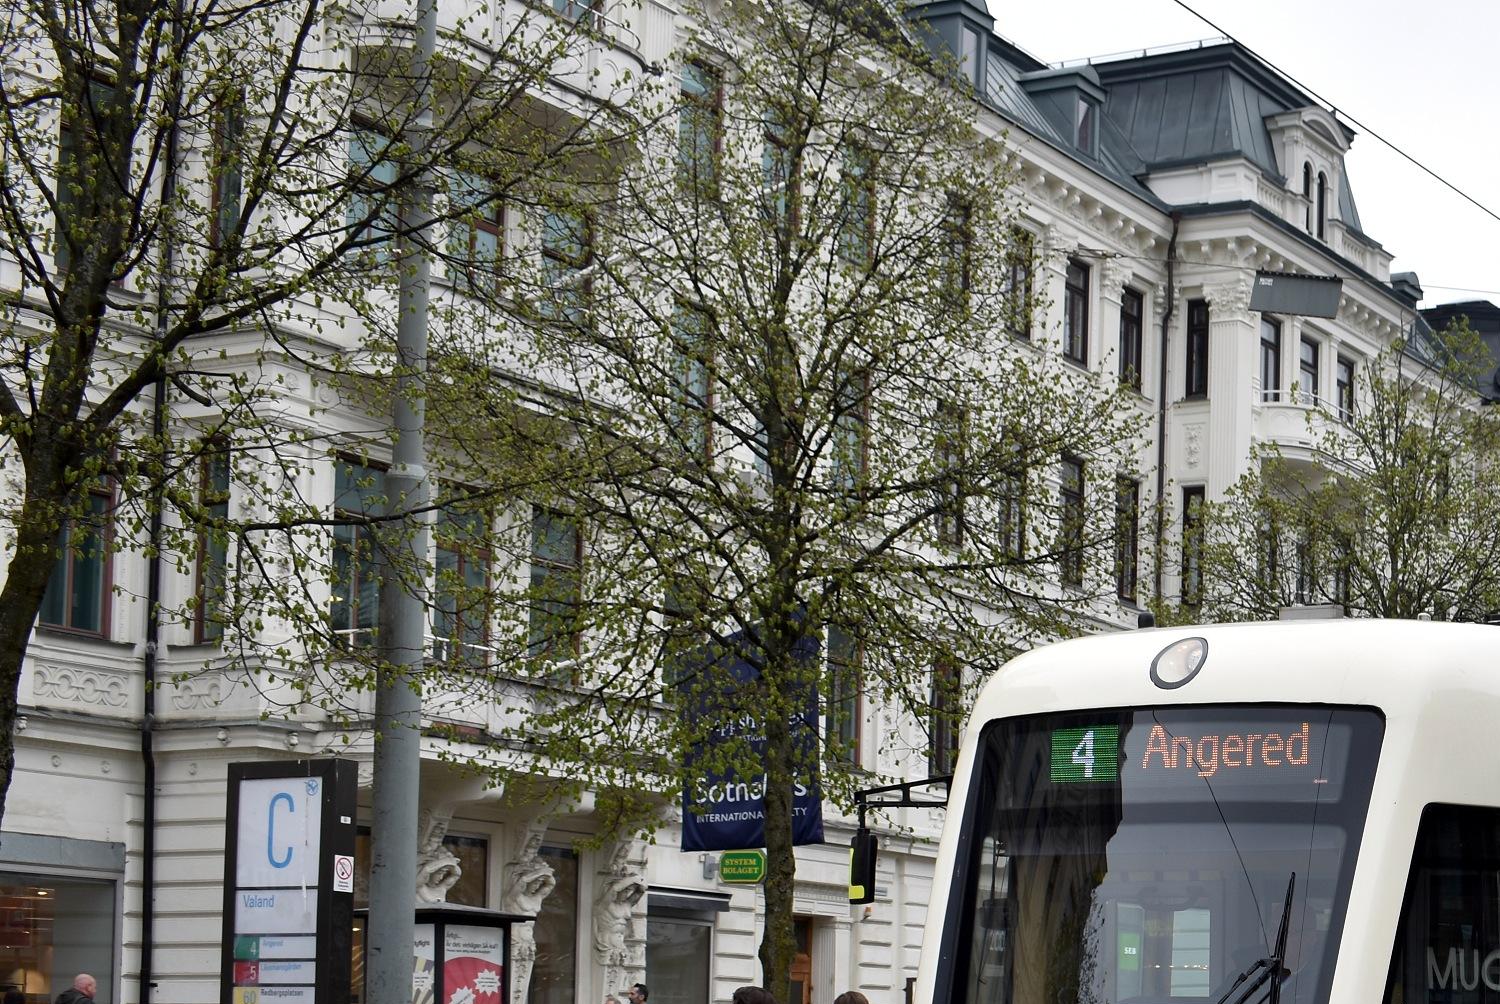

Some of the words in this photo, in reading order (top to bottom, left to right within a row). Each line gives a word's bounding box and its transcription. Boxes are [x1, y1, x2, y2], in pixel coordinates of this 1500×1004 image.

[1072, 730, 1095, 777] 4
[1142, 722, 1309, 777] Angered
[697, 811, 764, 824] INTERNATIONA
[268, 793, 294, 868] C
[725, 858, 757, 866] SYSTEM
[243, 894, 275, 908] Valand
[250, 941, 258, 956] 4
[249, 965, 257, 981] 5
[243, 990, 256, 1004] 60
